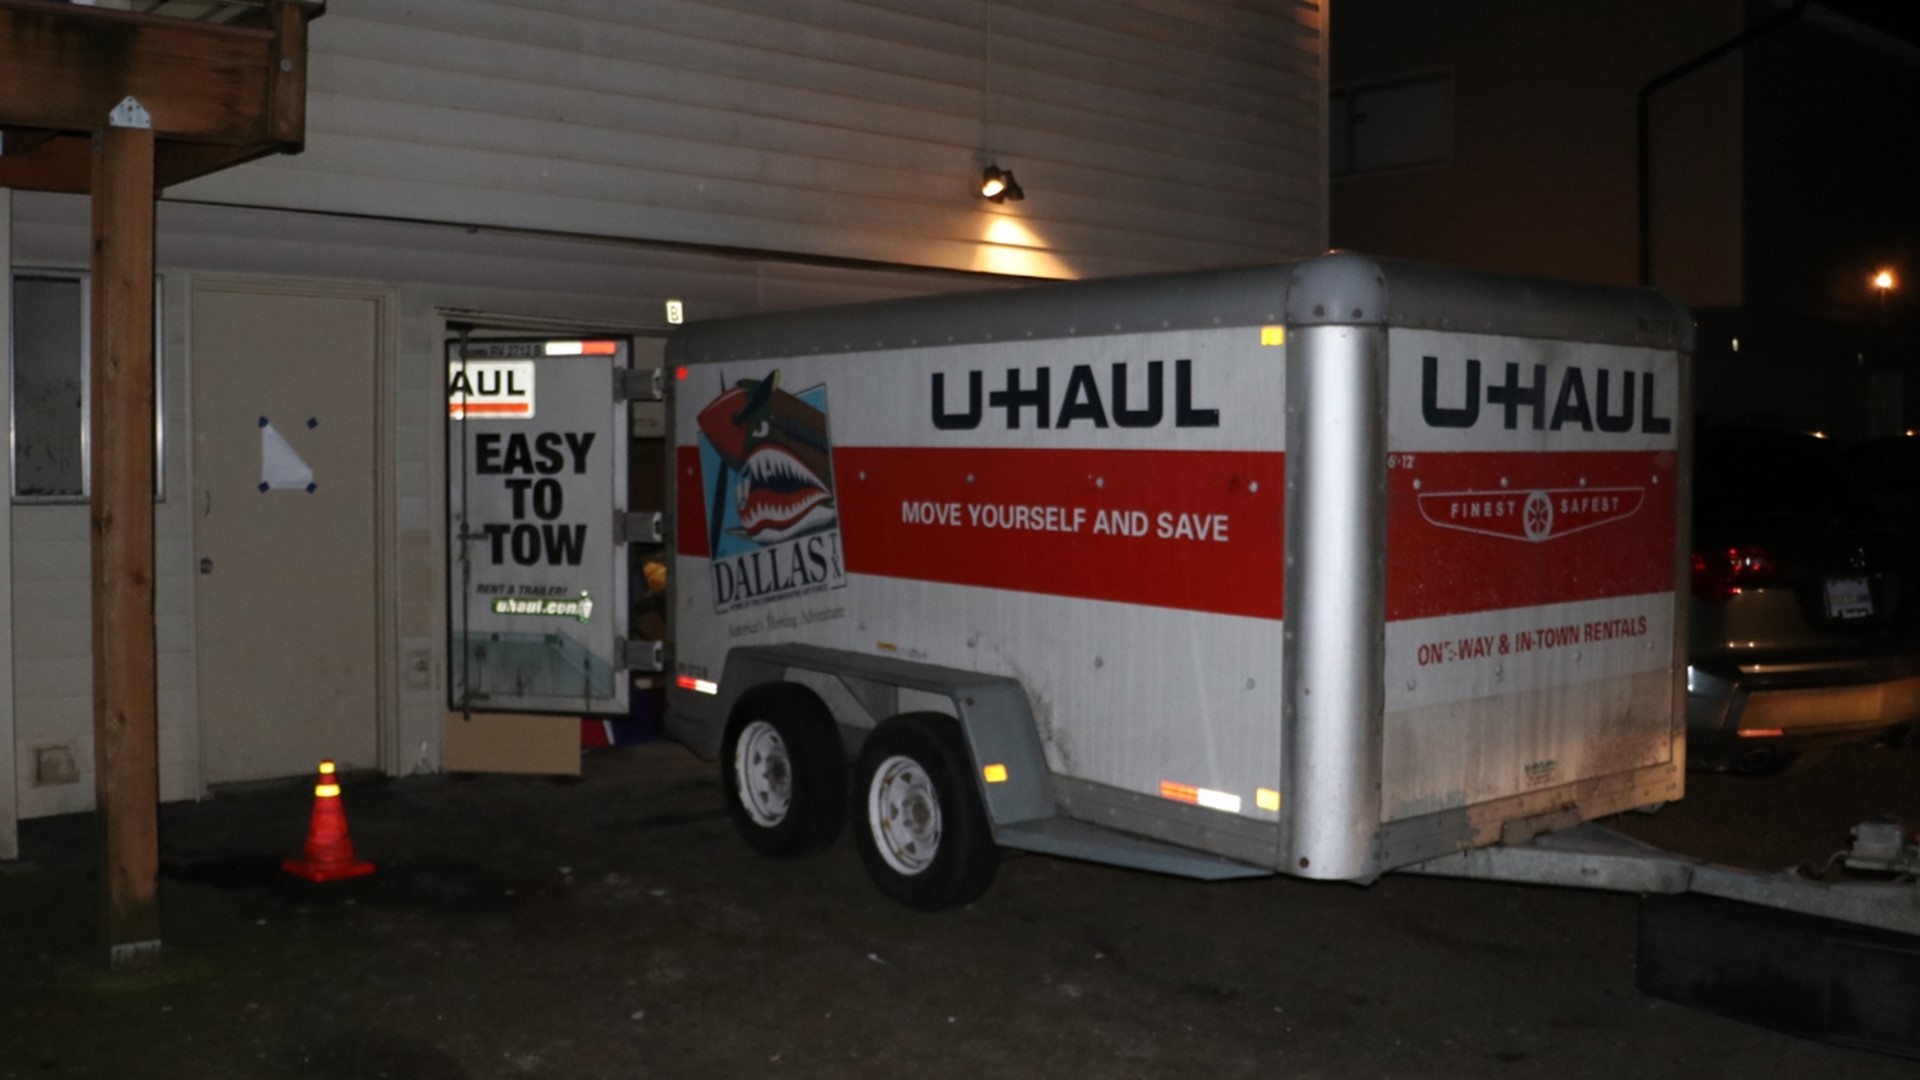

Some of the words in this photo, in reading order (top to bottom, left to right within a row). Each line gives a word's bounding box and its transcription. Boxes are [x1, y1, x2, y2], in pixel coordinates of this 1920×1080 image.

[449, 370, 526, 397] AUL
[931, 359, 1220, 430] U-HAUL
[1422, 356, 1671, 434] U-HAUL
[475, 433, 597, 475] EASY
[504, 478, 563, 521] TO
[1451, 501, 1516, 518] FINEST
[1560, 497, 1620, 514] SAFEST
[901, 501, 962, 527] MOVE
[967, 503, 1087, 533] YOURSELF
[1093, 510, 1149, 537] AND
[1156, 512, 1230, 542] SAVE
[483, 524, 588, 567] TOW
[477, 584, 505, 594] RENT
[507, 585, 516, 594] A
[518, 586, 568, 596] TRAILER!
[713, 535, 828, 605] DALLAS
[1498, 633, 1510, 655] &
[1515, 625, 1580, 653] IN-TOWN
[1584, 615, 1647, 642] RENTALS
